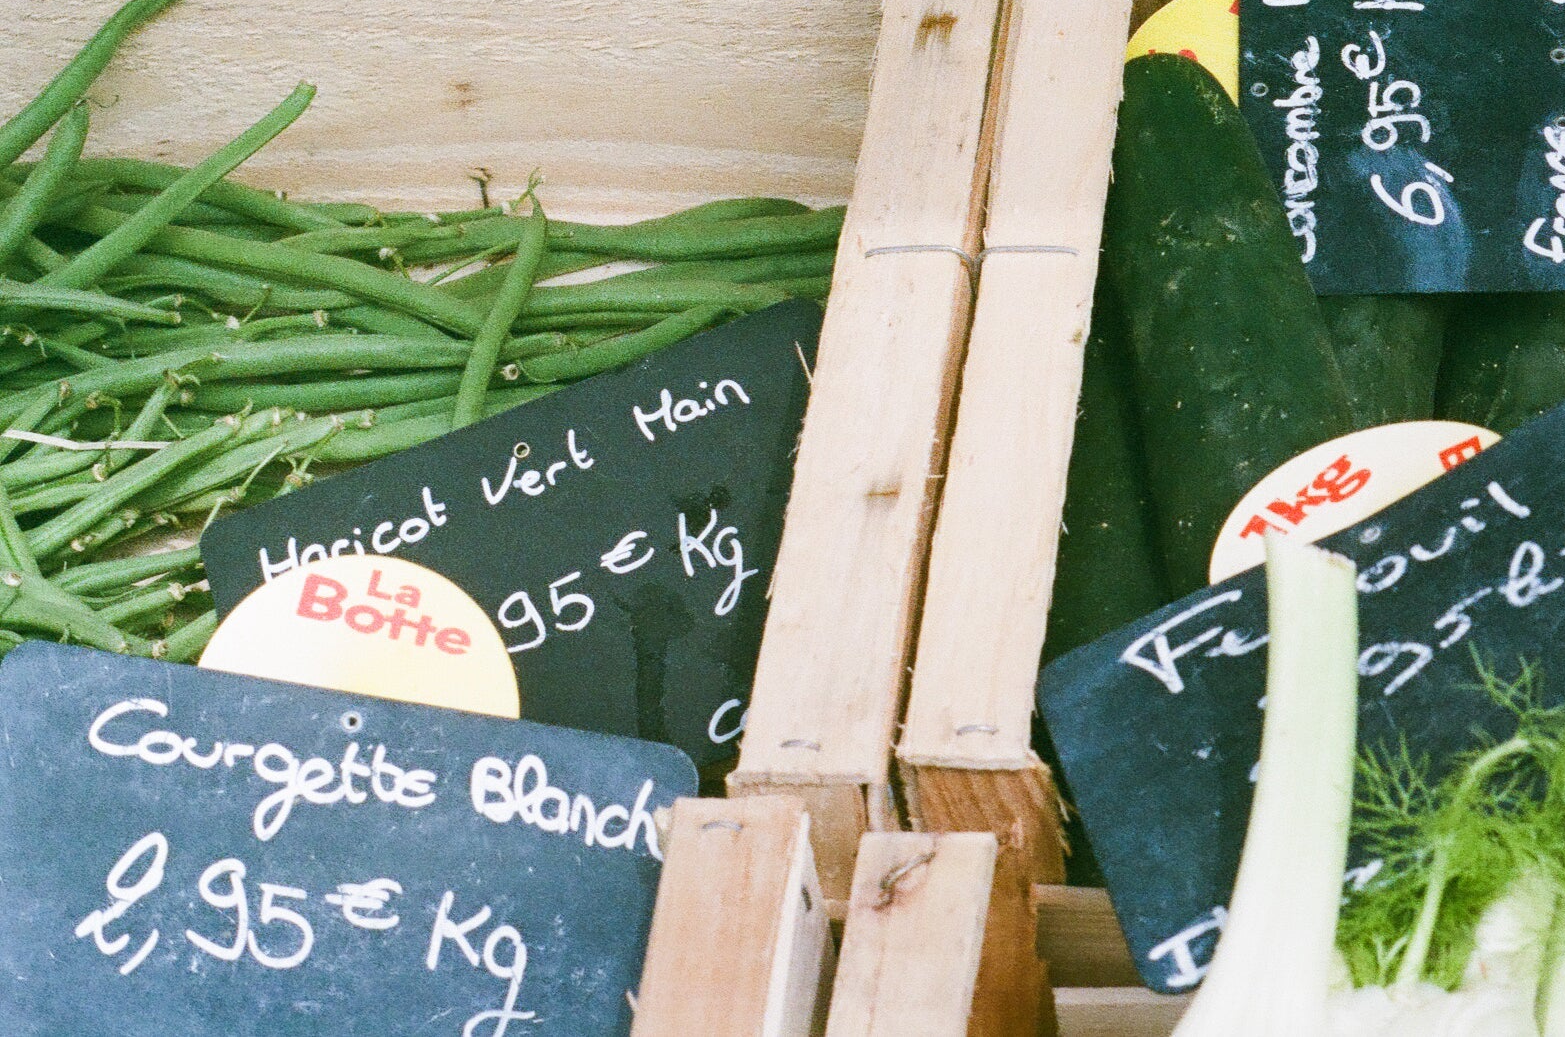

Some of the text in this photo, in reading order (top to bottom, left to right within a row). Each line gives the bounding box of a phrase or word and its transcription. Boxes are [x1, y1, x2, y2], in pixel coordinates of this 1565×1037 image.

[259, 378, 751, 583] Haricot Vert Main
[295, 573, 472, 655] Botte
[366, 569, 422, 609] La
[677, 509, 761, 617] Kg
[88, 697, 666, 862] Courgette Blanch
[426, 890, 536, 1037] Kg
